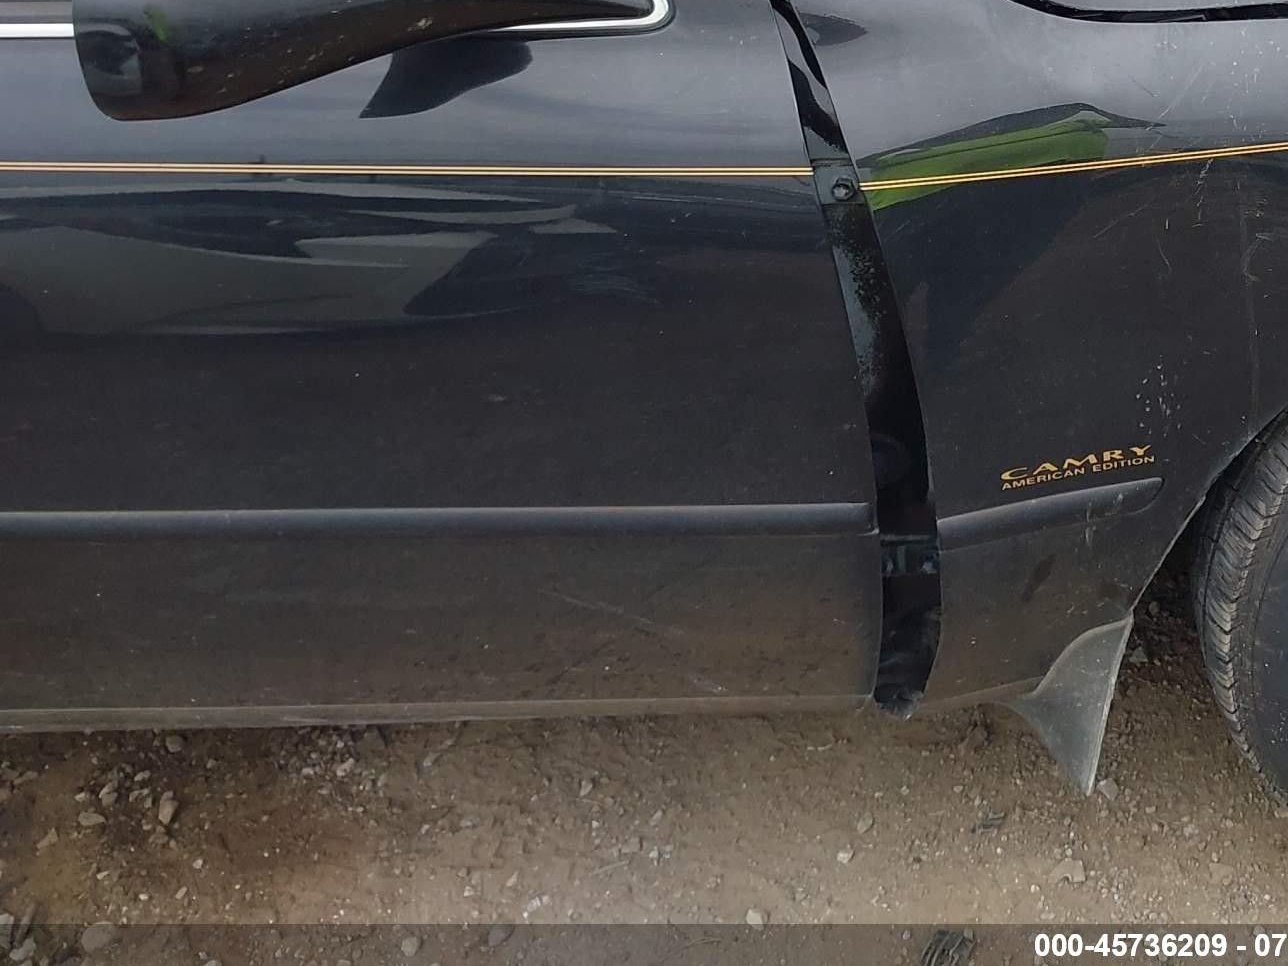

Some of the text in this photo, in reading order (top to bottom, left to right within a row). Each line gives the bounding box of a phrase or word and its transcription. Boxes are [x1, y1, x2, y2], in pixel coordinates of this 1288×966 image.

[1000, 444, 1151, 480] CAMRY
[1001, 456, 1155, 490] AMERICAN EDITION
